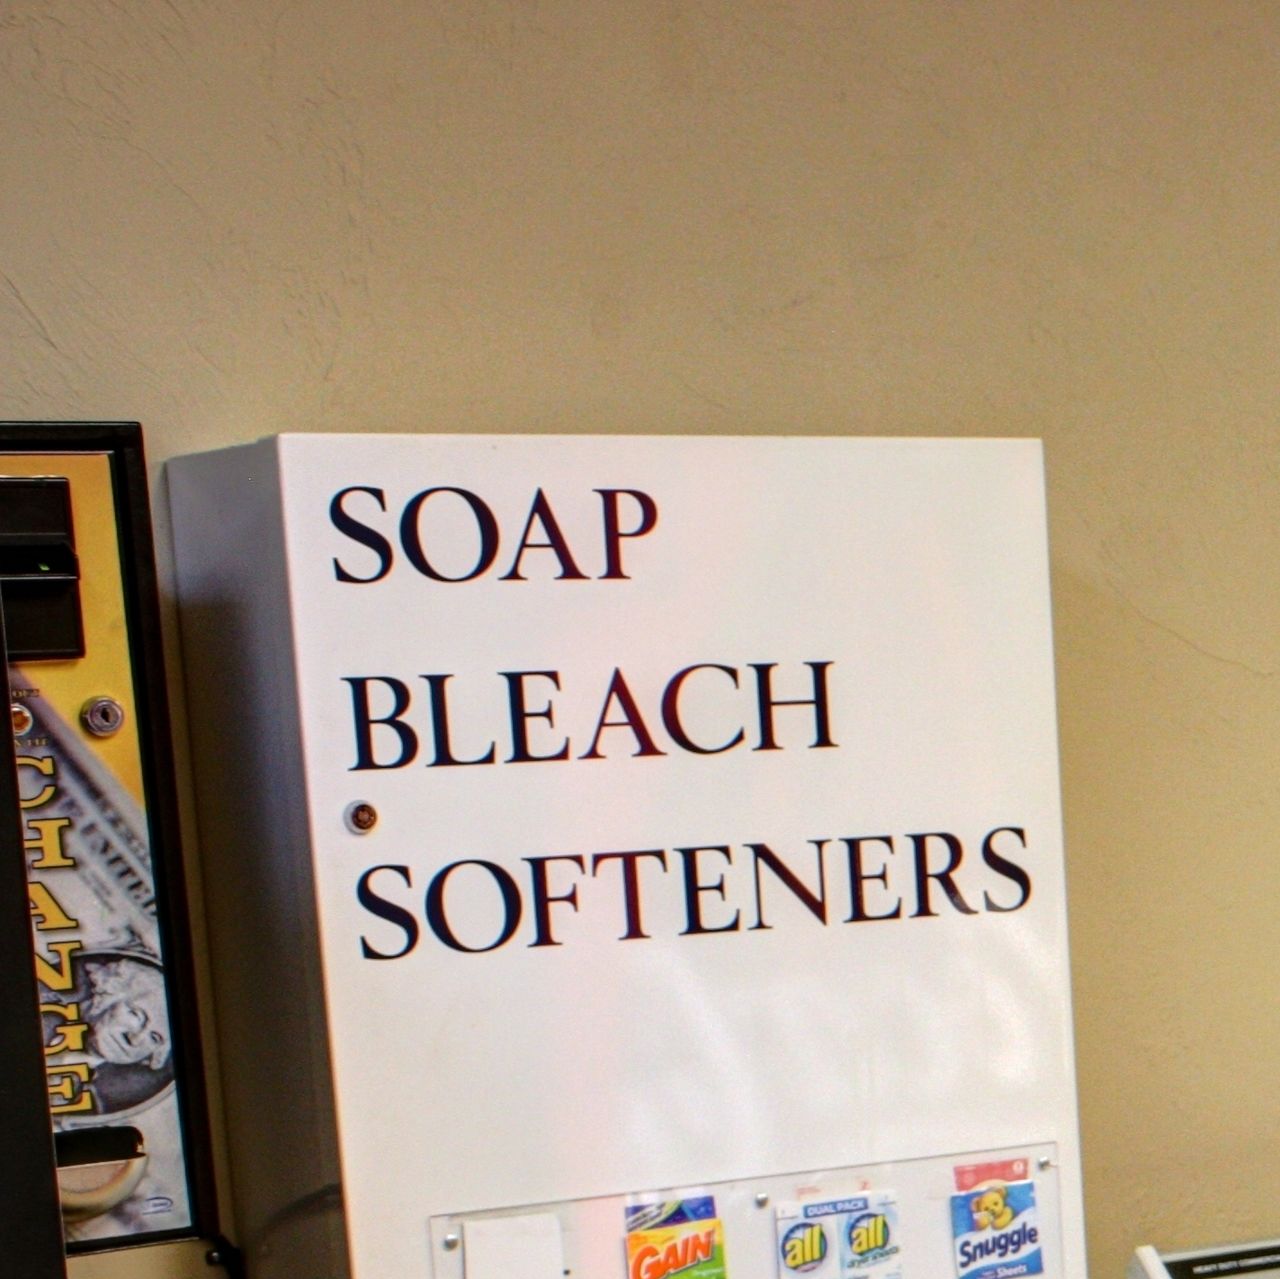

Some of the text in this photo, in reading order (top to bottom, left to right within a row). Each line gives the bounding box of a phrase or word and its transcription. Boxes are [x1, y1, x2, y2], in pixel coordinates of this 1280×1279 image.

[328, 485, 658, 584] SOAP
[340, 660, 839, 772] BLEACH
[355, 826, 1032, 960] SOFTENERS
[807, 1199, 864, 1217] DUAL PACK
[784, 1223, 823, 1269] all
[851, 1213, 885, 1255] all
[959, 1221, 1038, 1268] Snuggle
